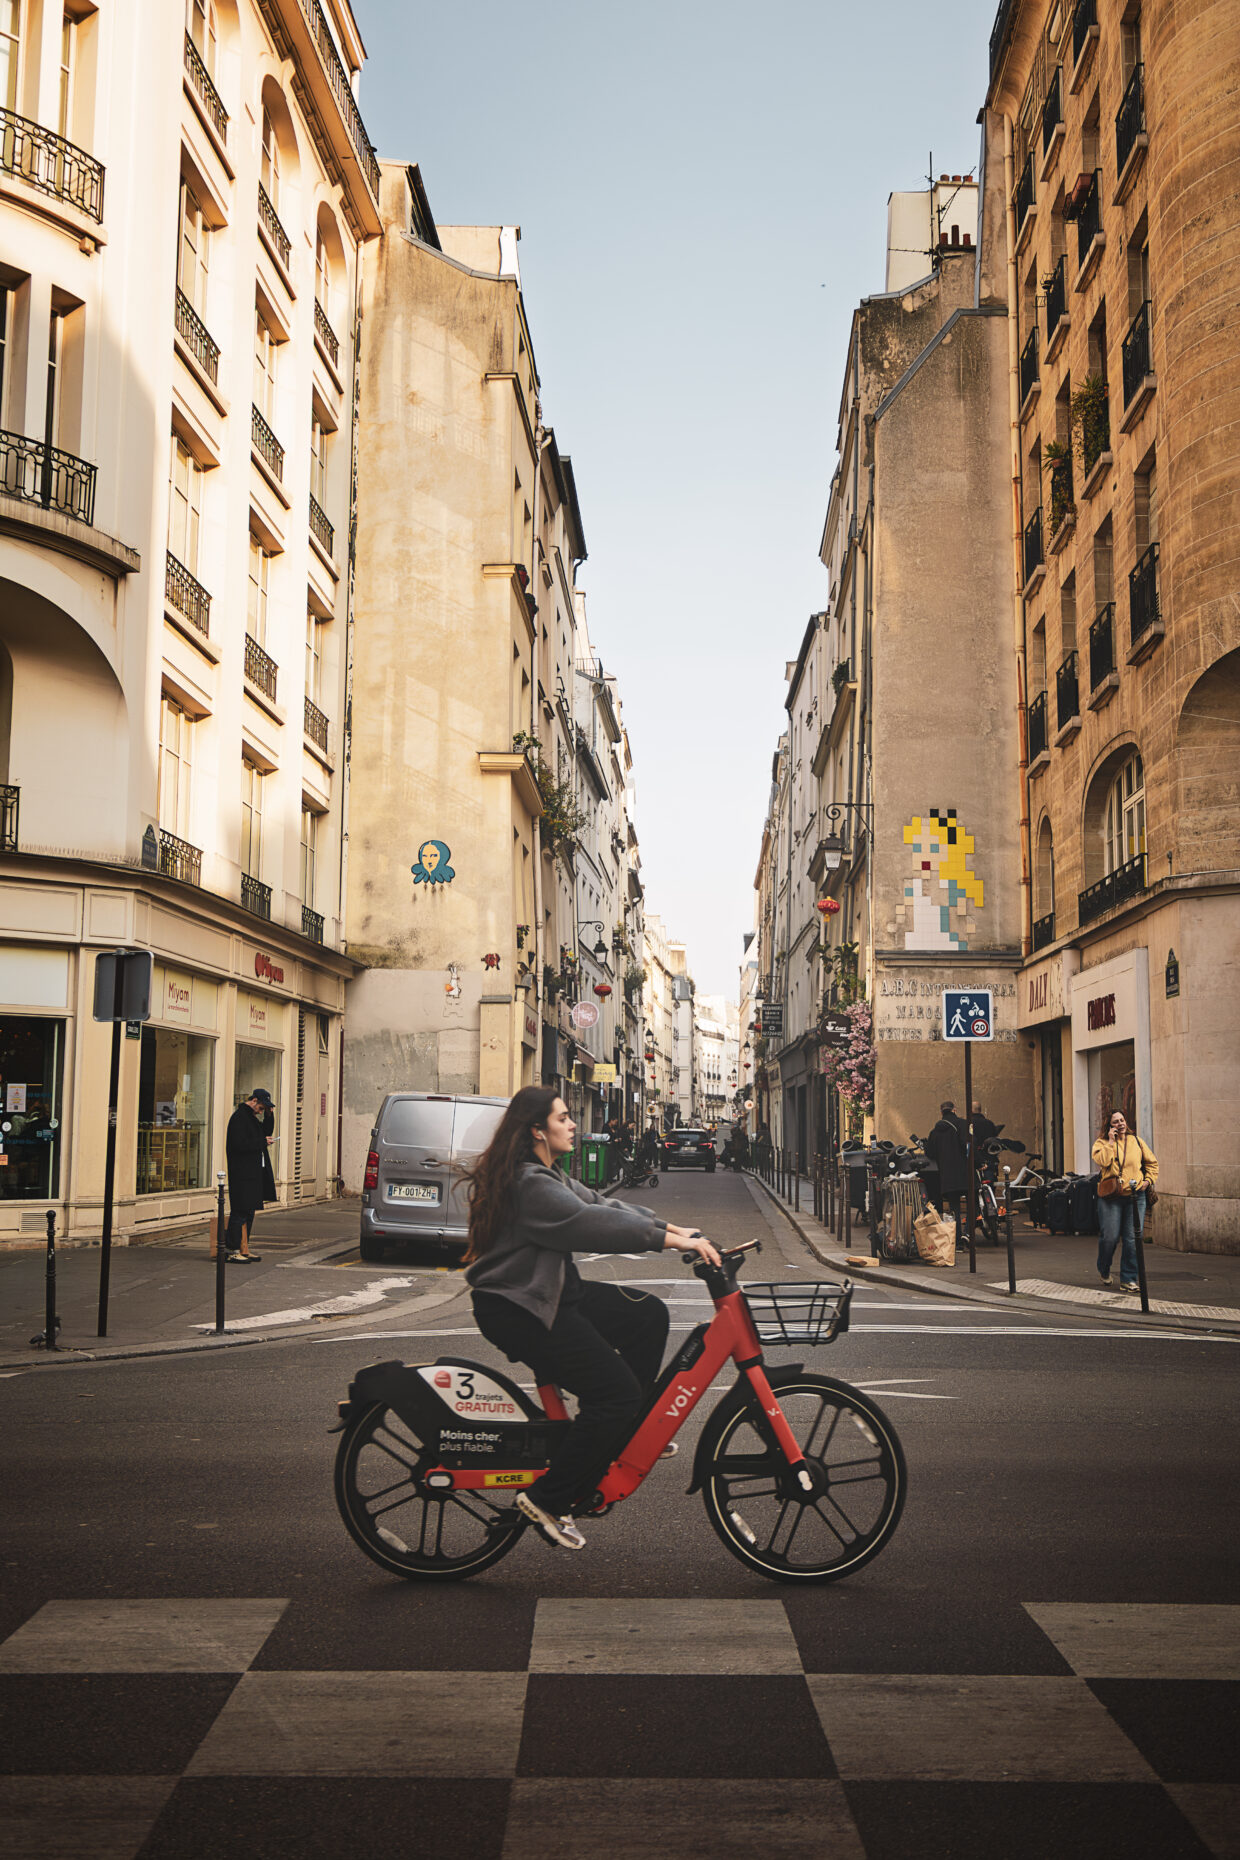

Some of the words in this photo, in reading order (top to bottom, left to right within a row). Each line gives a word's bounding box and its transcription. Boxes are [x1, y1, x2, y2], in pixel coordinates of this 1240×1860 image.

[261, 954, 284, 984] Miyam
[168, 982, 190, 1003] Miyam
[1028, 972, 1049, 1013] DALY
[250, 1004, 266, 1022] Miyam
[455, 1372, 475, 1400] 3
[475, 1393, 503, 1402] trajets
[455, 1401, 515, 1414] GRATUITS
[440, 1429, 473, 1440] Moins
[440, 1441, 462, 1452] plus
[495, 1474, 524, 1484] KCRE
